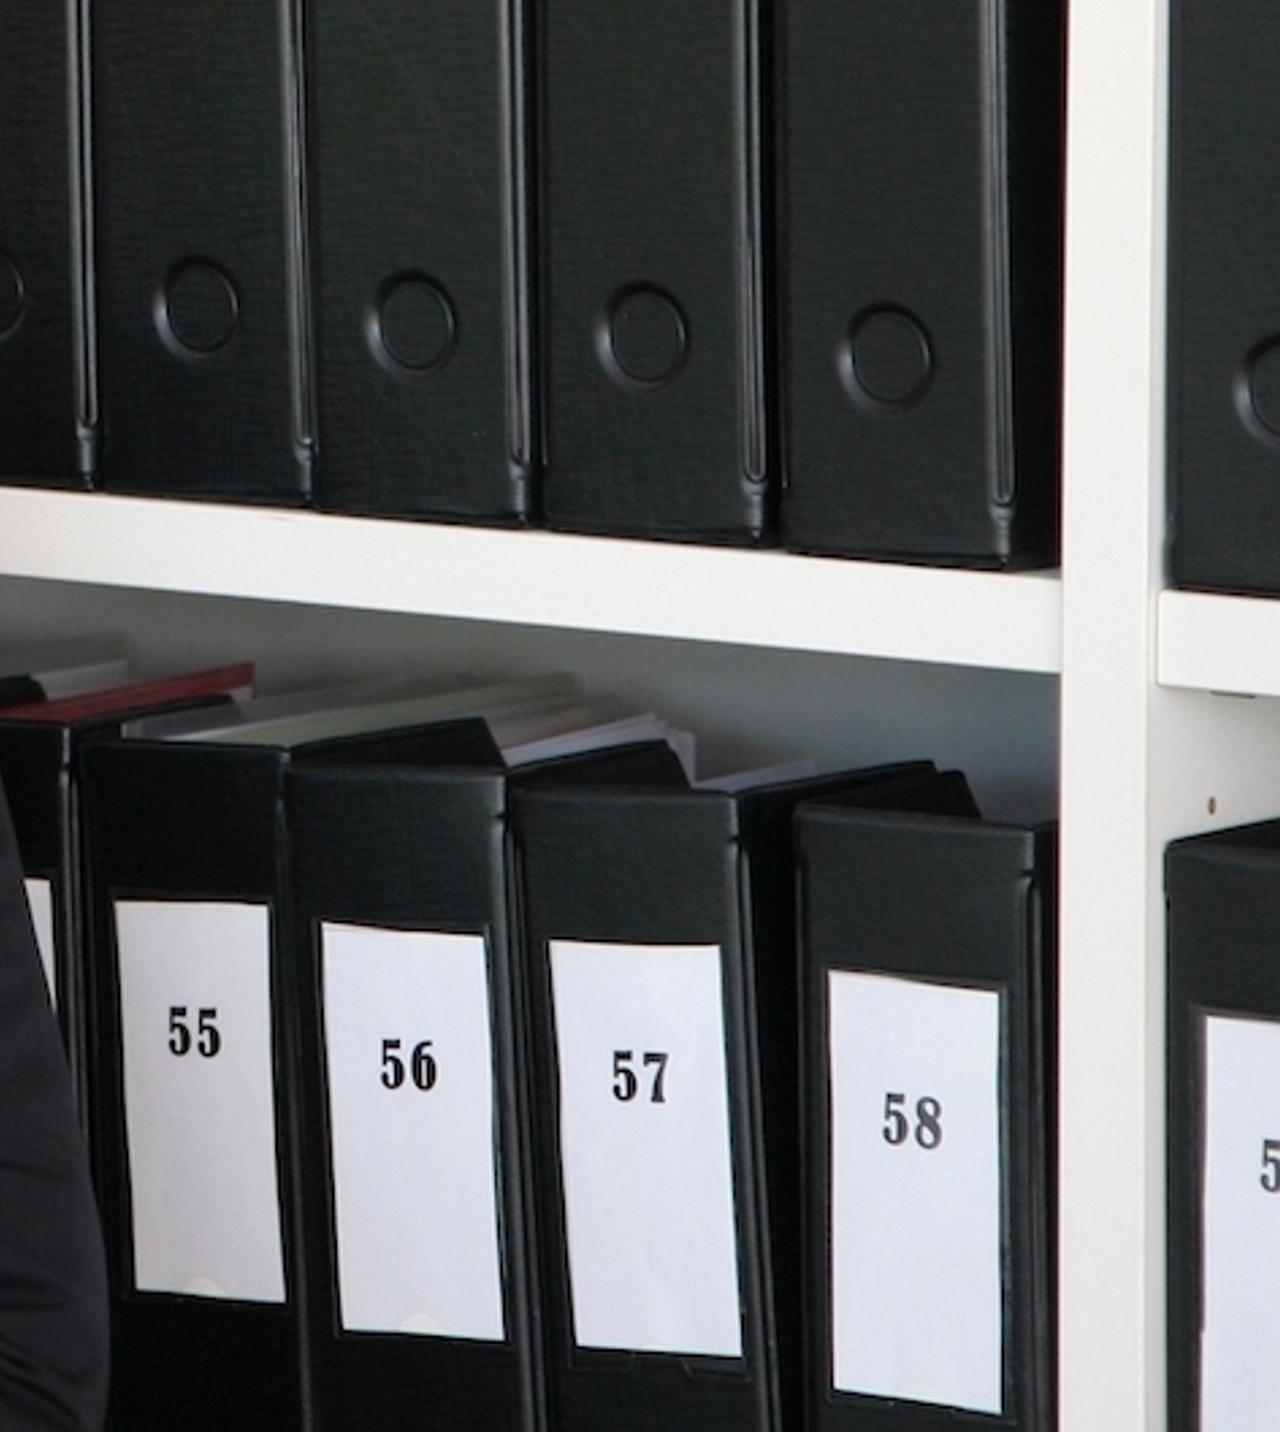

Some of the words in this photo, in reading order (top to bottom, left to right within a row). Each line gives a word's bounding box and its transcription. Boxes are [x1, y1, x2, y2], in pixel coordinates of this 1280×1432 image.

[168, 1005, 222, 1059] 55
[380, 1038, 437, 1092] 56
[612, 1049, 669, 1104] 57
[881, 1091, 943, 1150] 58
